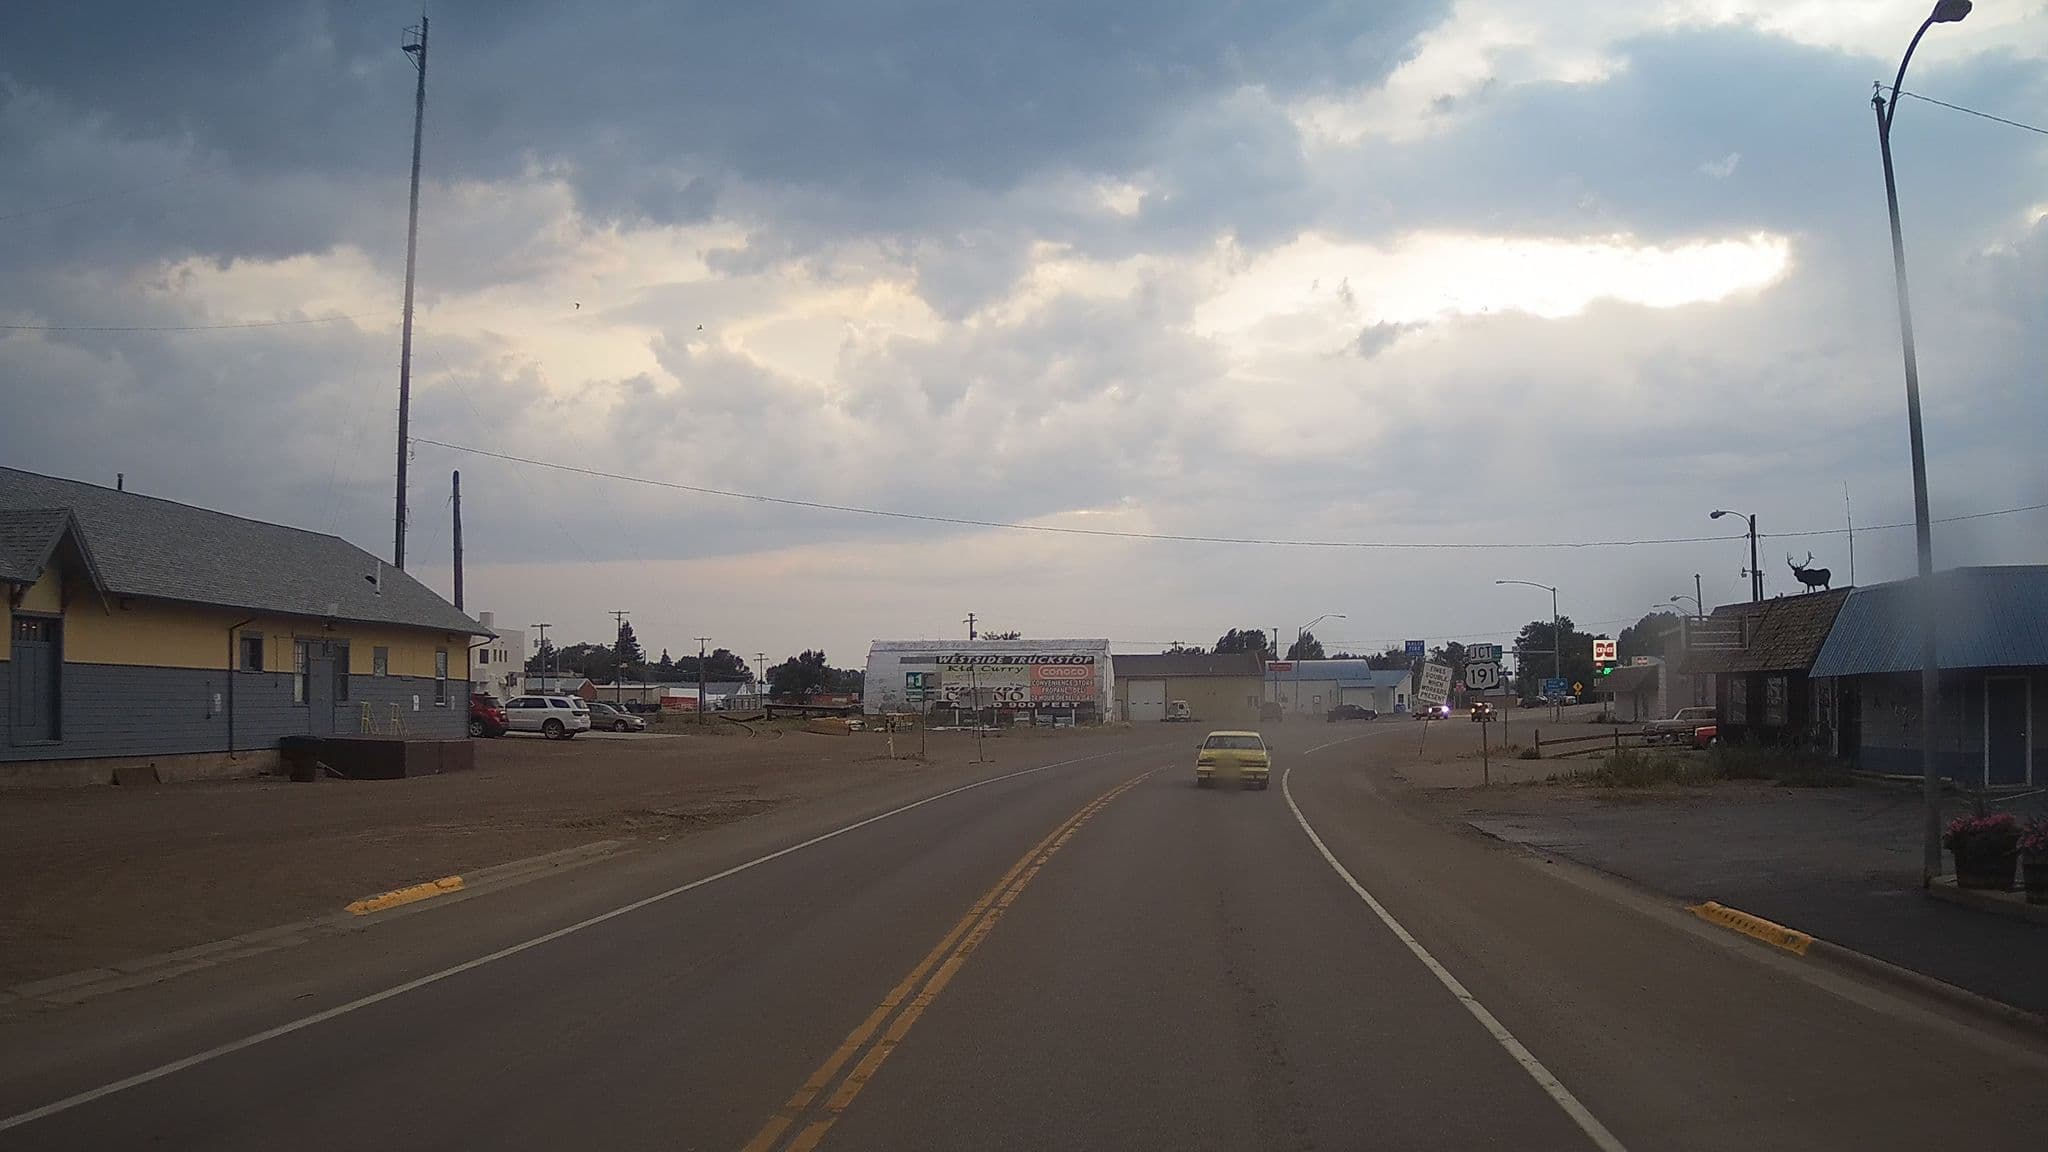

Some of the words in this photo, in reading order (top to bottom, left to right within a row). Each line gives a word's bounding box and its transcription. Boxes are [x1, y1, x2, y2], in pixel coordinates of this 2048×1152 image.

[1472, 646, 1492, 659] JCT
[938, 656, 1004, 664] WESTSIDE
[1010, 656, 1092, 664] TRUCKSTOP
[981, 665, 1024, 674] Curry
[1471, 668, 1494, 684] 191
[1420, 692, 1446, 702] PRESENT
